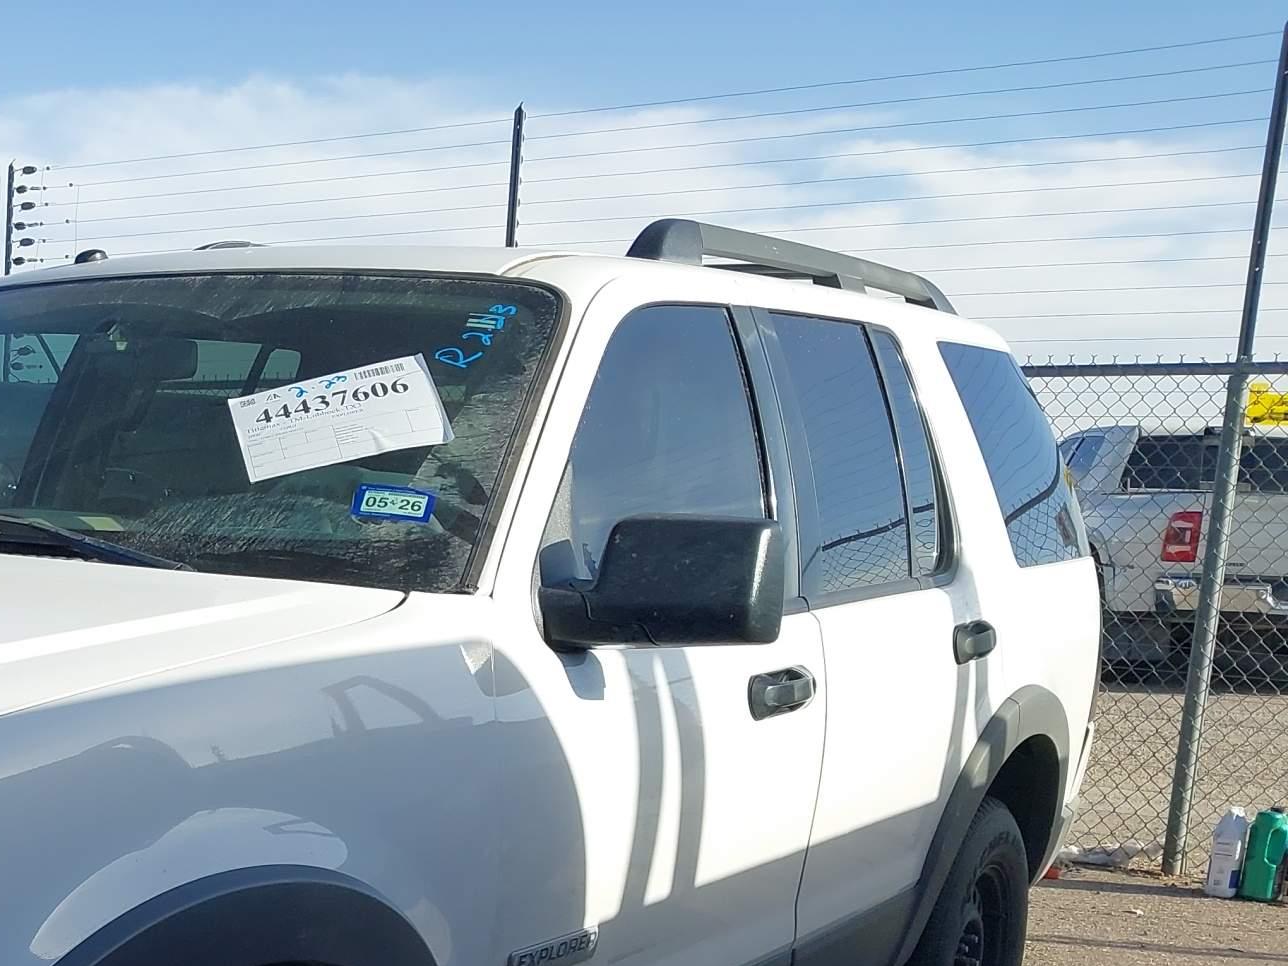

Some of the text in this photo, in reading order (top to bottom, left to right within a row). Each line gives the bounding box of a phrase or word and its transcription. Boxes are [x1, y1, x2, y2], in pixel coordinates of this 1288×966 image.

[255, 376, 410, 424] 44437606
[365, 496, 390, 508] 05
[398, 499, 423, 512] 26
